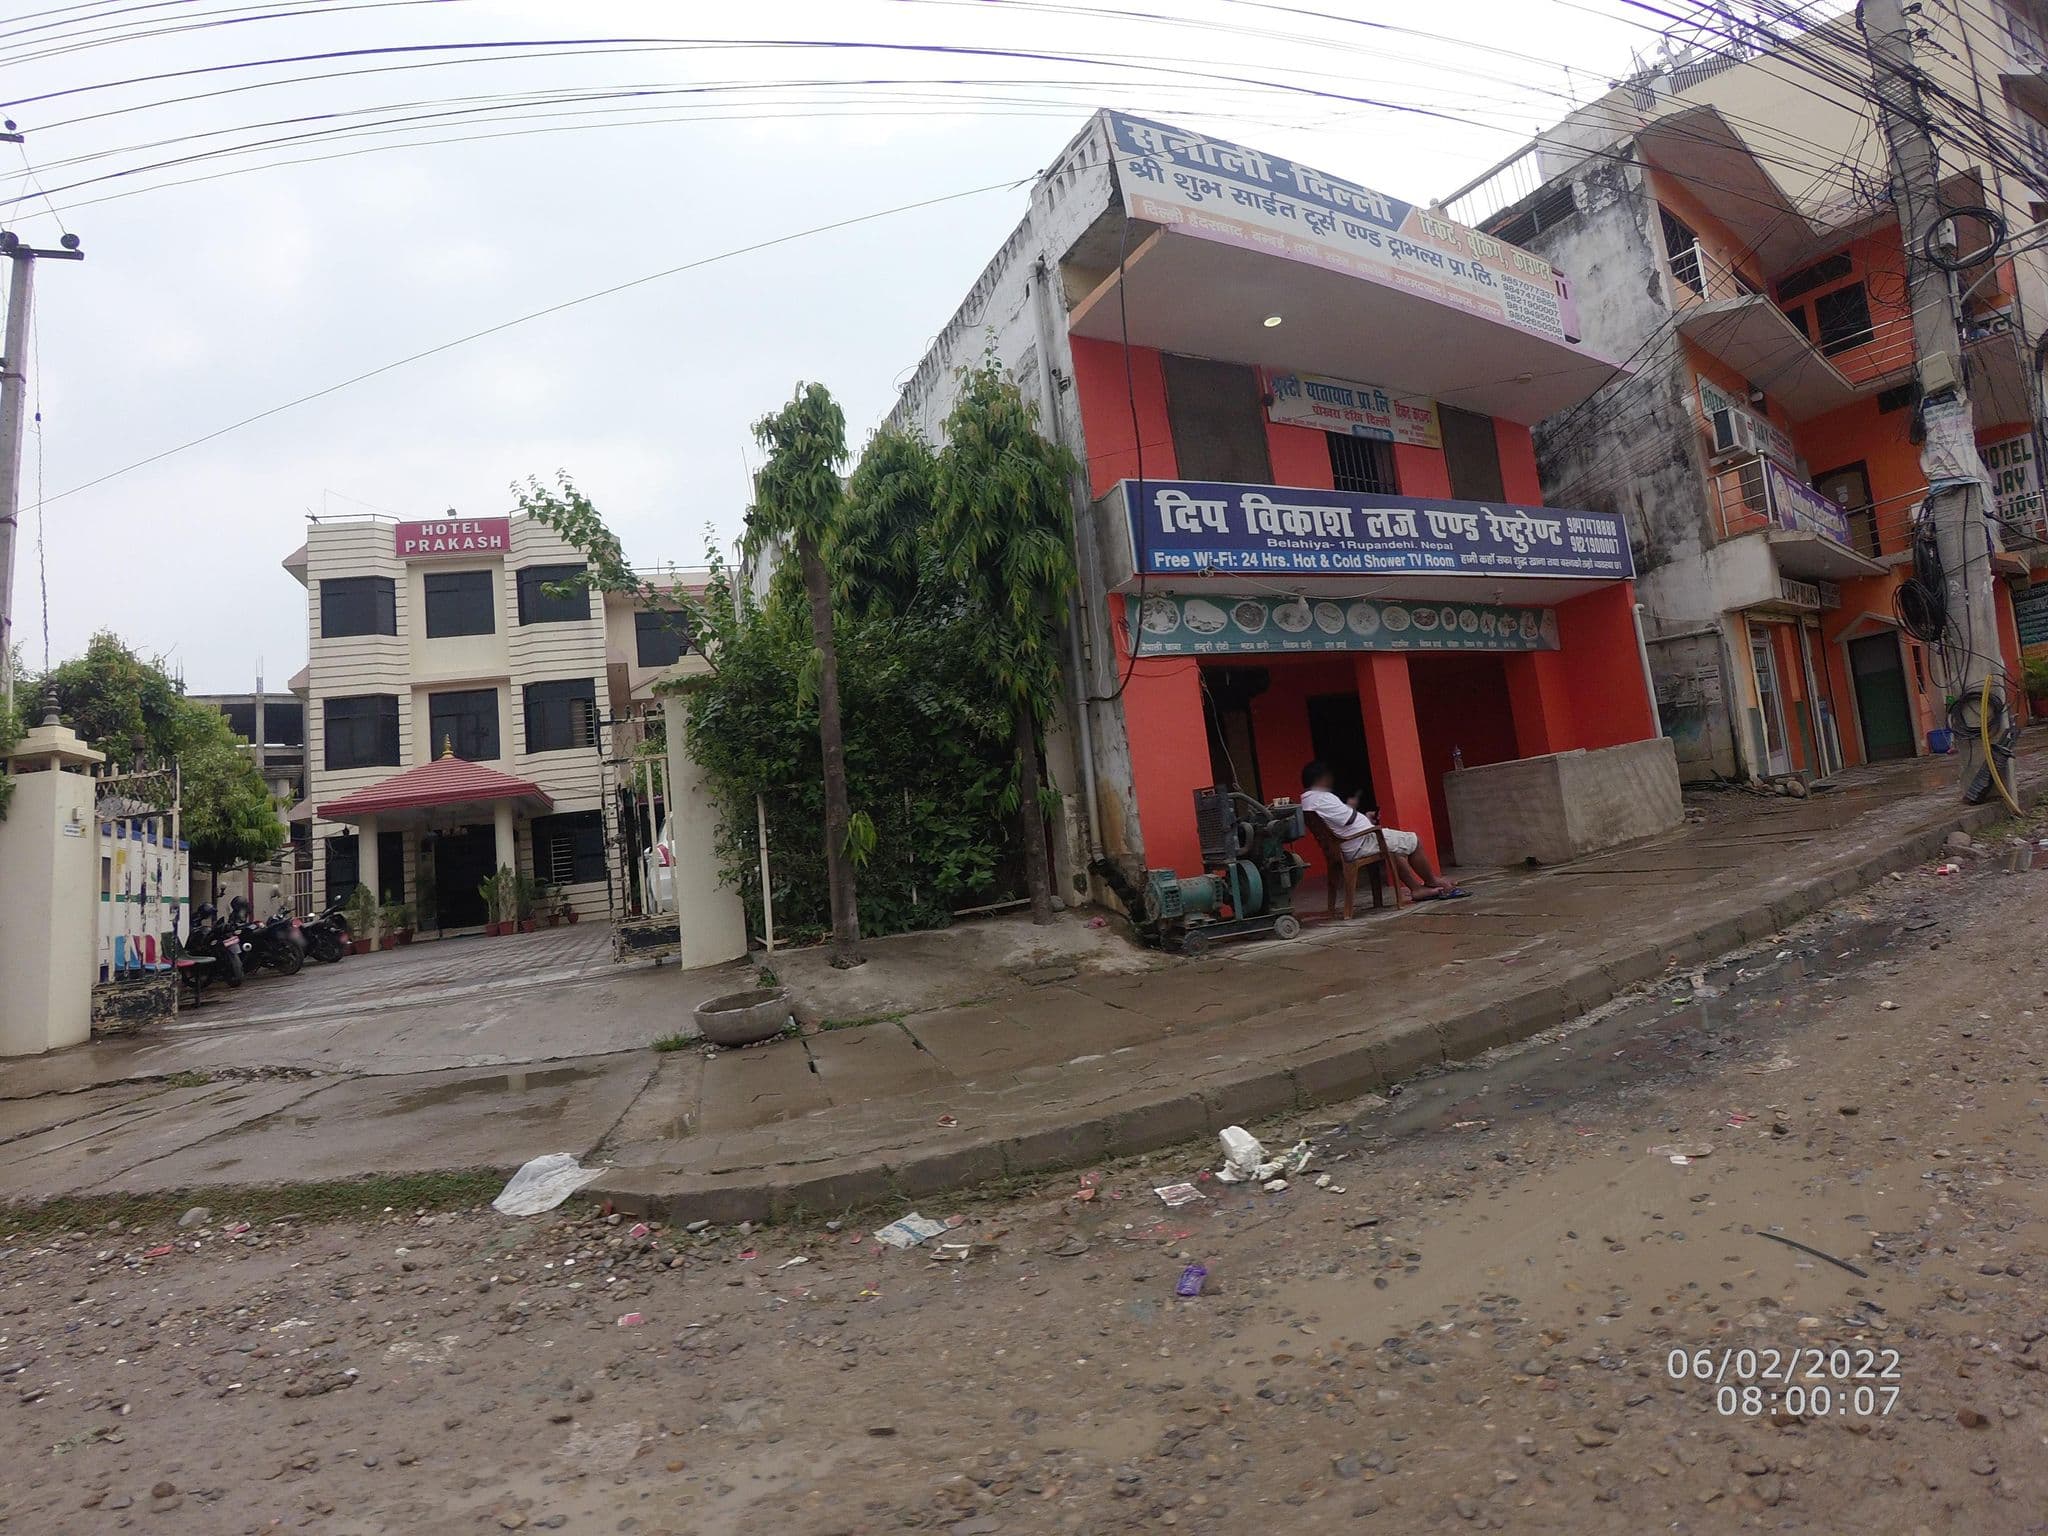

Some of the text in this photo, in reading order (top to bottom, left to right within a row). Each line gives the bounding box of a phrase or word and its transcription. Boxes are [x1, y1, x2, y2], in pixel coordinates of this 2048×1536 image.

[1129, 157, 1165, 184] श्री
[1173, 172, 1223, 202] शुभ
[1229, 186, 1297, 220] साईत
[1302, 208, 1336, 236] टूर्स
[1341, 220, 1382, 248] एण्ड
[1305, 381, 1354, 407] यातायात
[1154, 489, 1230, 533] दिप
[1240, 492, 1355, 538] विकाश
[1361, 508, 1419, 538] लज
[1424, 510, 1480, 541] एण्ड
[422, 522, 483, 536] HOTEL
[405, 535, 501, 553] PRAKASH
[1421, 541, 1454, 551] Nepal
[1154, 551, 1455, 568] Free Wi-Fi: 24 Hrs. Hot & Cold Shower TV Room
